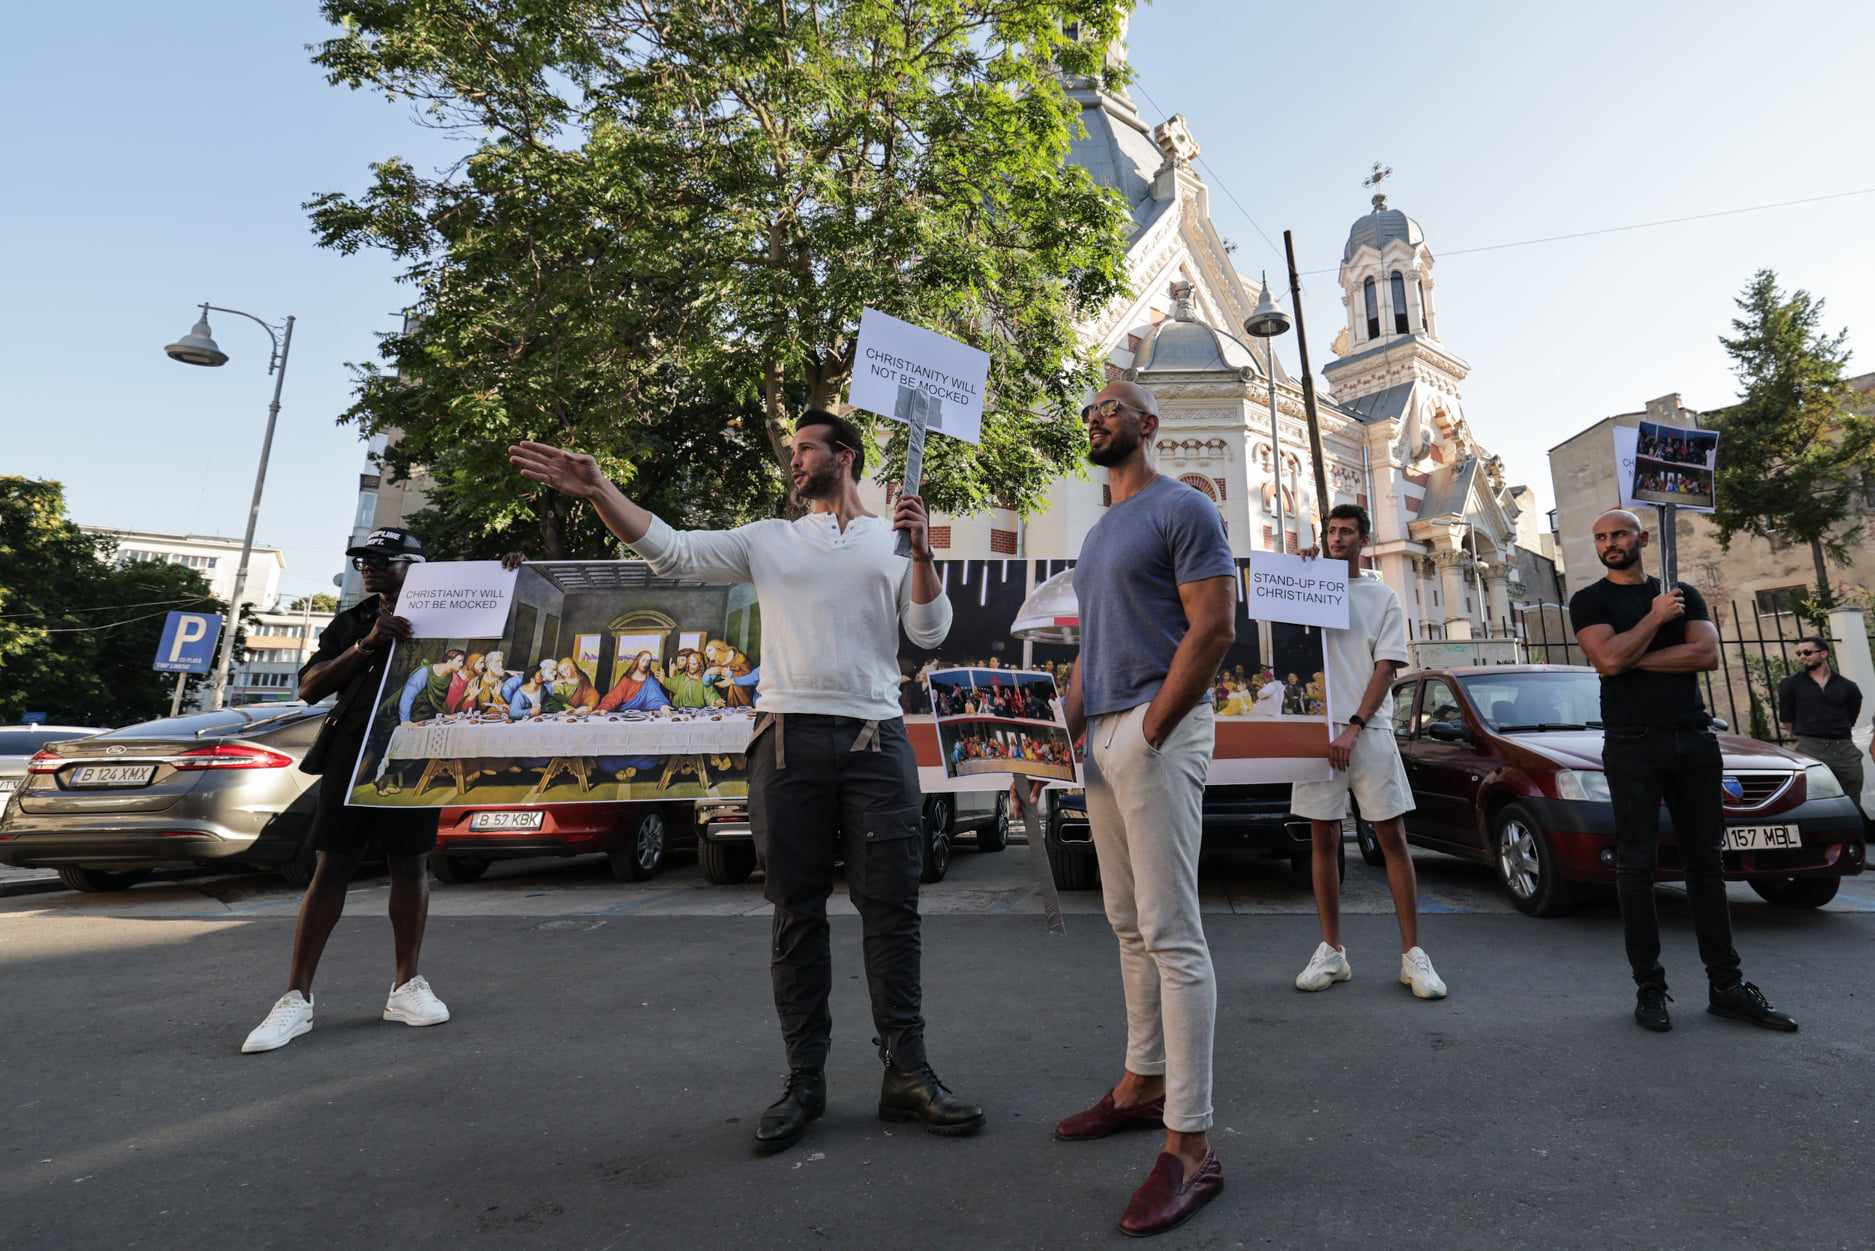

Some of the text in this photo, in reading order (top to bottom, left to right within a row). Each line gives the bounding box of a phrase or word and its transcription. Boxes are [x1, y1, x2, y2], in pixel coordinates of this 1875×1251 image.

[866, 347, 977, 395] CHRISTIANITY WILL
[870, 364, 969, 405] NOT BE MOCKED
[1254, 572, 1345, 592] STAND-UP FOR
[406, 589, 505, 599] CHRISTIANITY WILL
[1256, 586, 1343, 606] CHRISTIANITY
[408, 600, 497, 609] NOT BE MOCKED
[169, 615, 207, 662] P
[82, 767, 150, 781] B 124 XMX
[480, 814, 537, 826] B 57 KBK
[1731, 828, 1757, 847] 157
[1764, 827, 1797, 846] MBL
